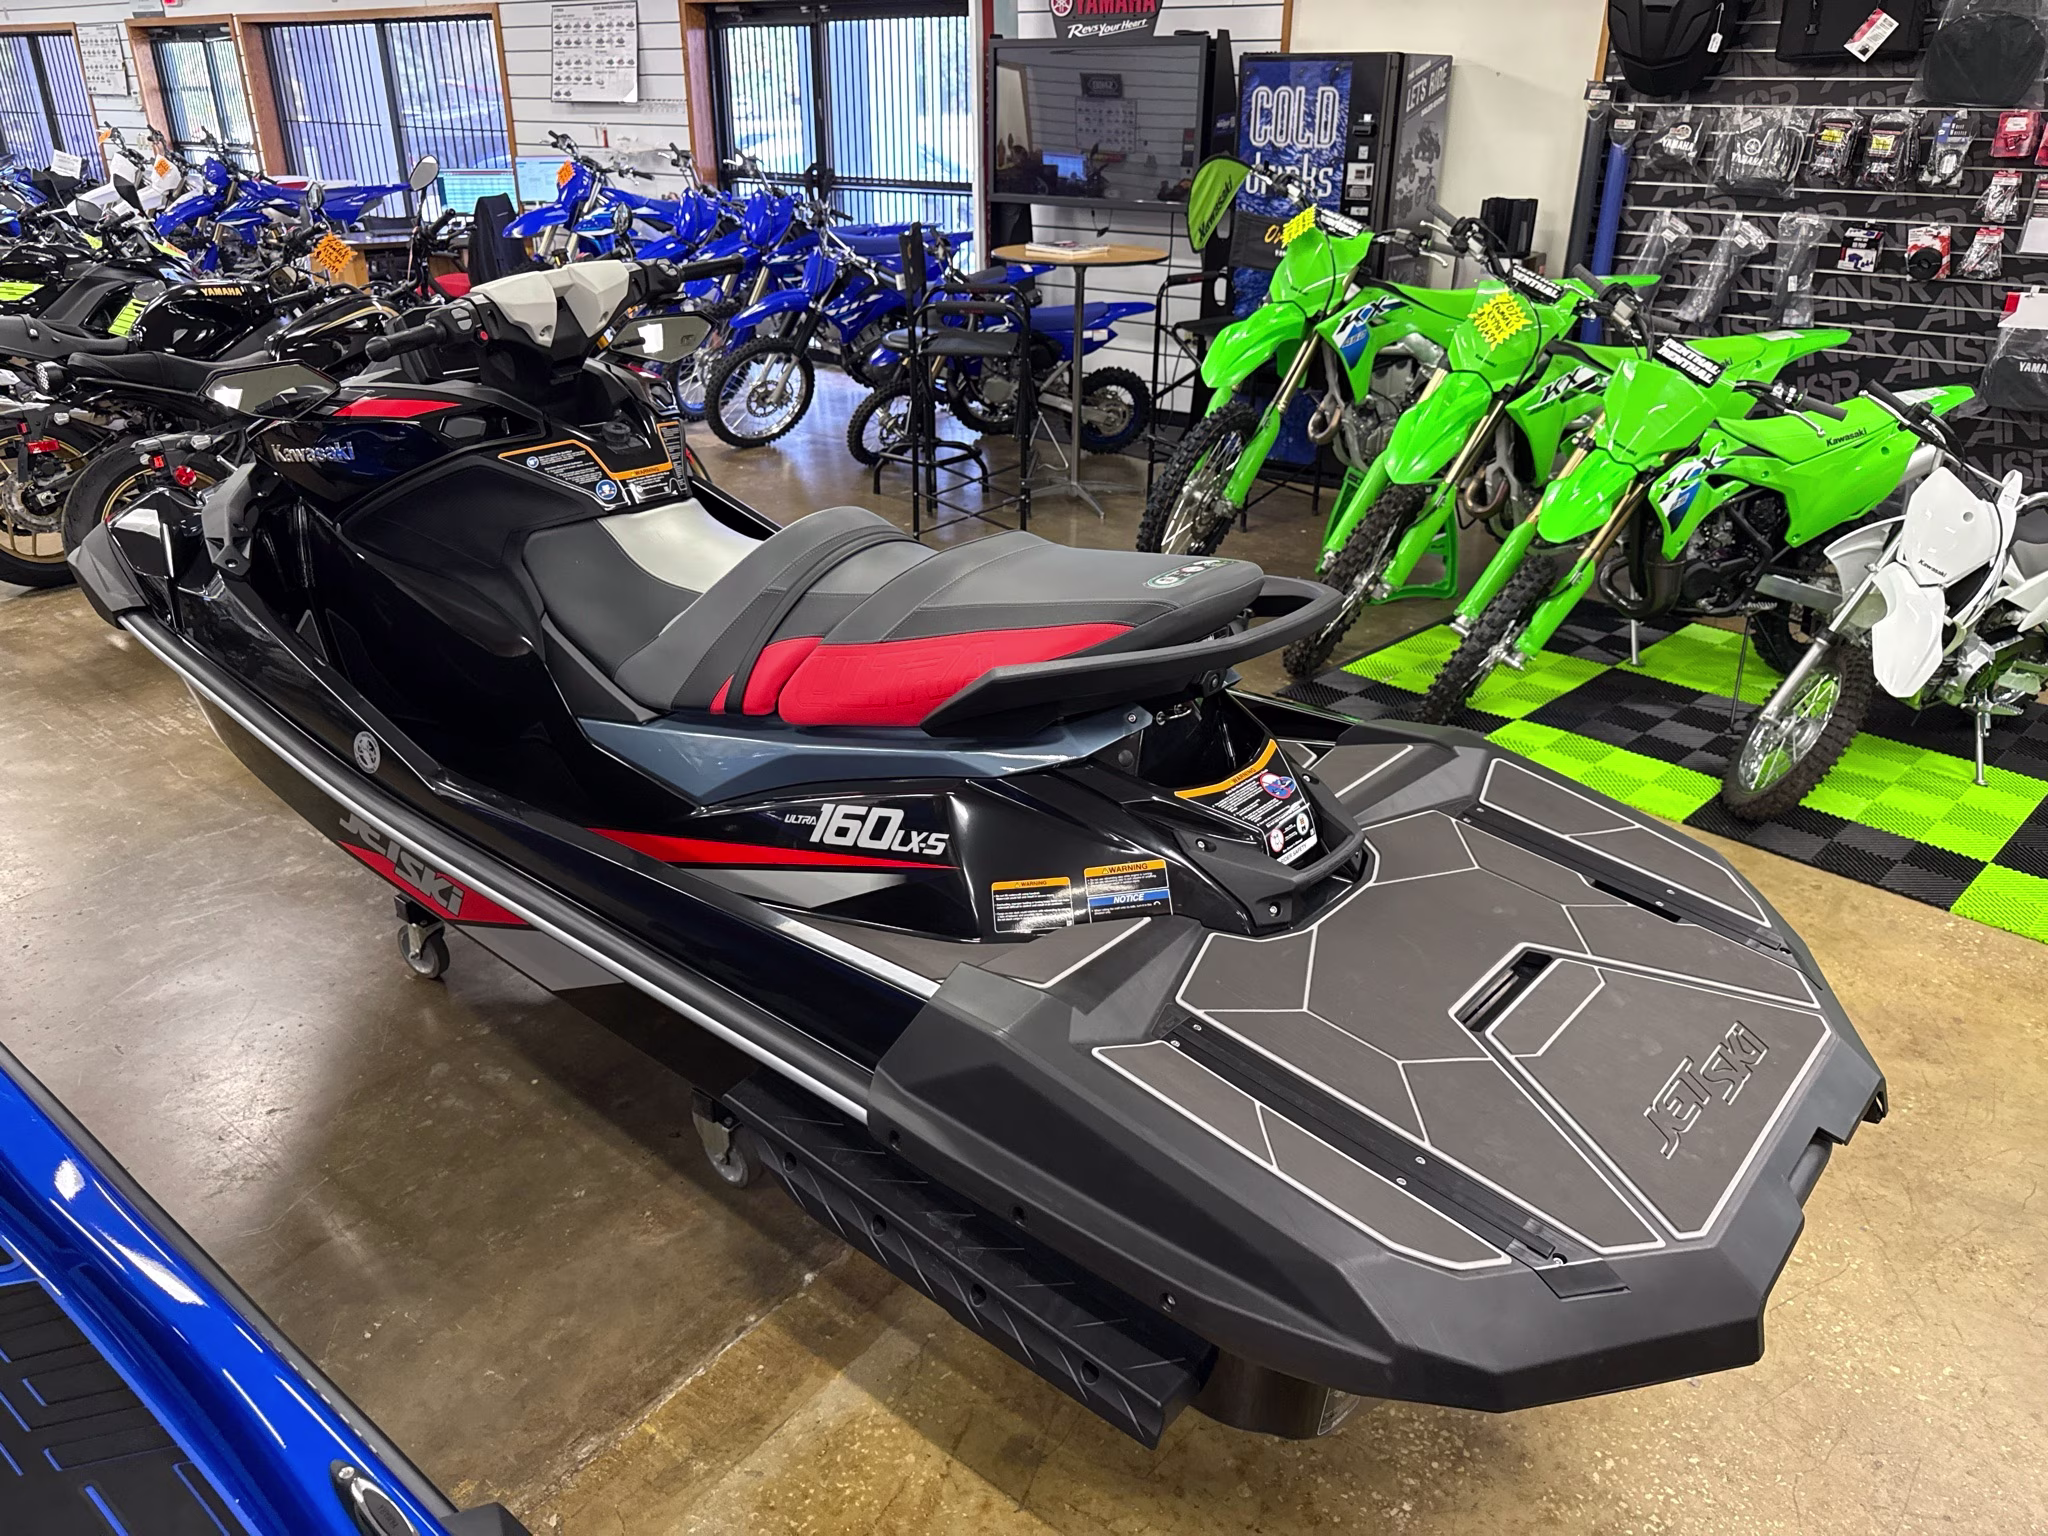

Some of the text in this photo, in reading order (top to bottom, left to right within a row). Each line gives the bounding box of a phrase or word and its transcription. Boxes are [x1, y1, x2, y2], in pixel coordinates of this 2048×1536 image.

[1076, 0, 1157, 15] YAMAHA
[1067, 19, 1148, 38] Revs Your Heart
[1250, 85, 1340, 148] COLD
[1662, 138, 1695, 151] YAMAHA
[1731, 152, 1763, 166] YAMAHA
[201, 288, 244, 297] YAMAHA
[1657, 345, 1714, 384] RENTHAL
[1663, 337, 1721, 375] RENTHAL
[2019, 361, 2048, 374] YAMA
[1826, 427, 1868, 448] Kawasaki
[271, 441, 355, 463] Kawasaki
[1918, 558, 1947, 578] Kawasaki
[1232, 767, 1258, 784] WARNING
[784, 803, 950, 856] ULTRA 160 LX-S
[1109, 862, 1148, 873] WARNING
[1113, 893, 1145, 904] NOTICE
